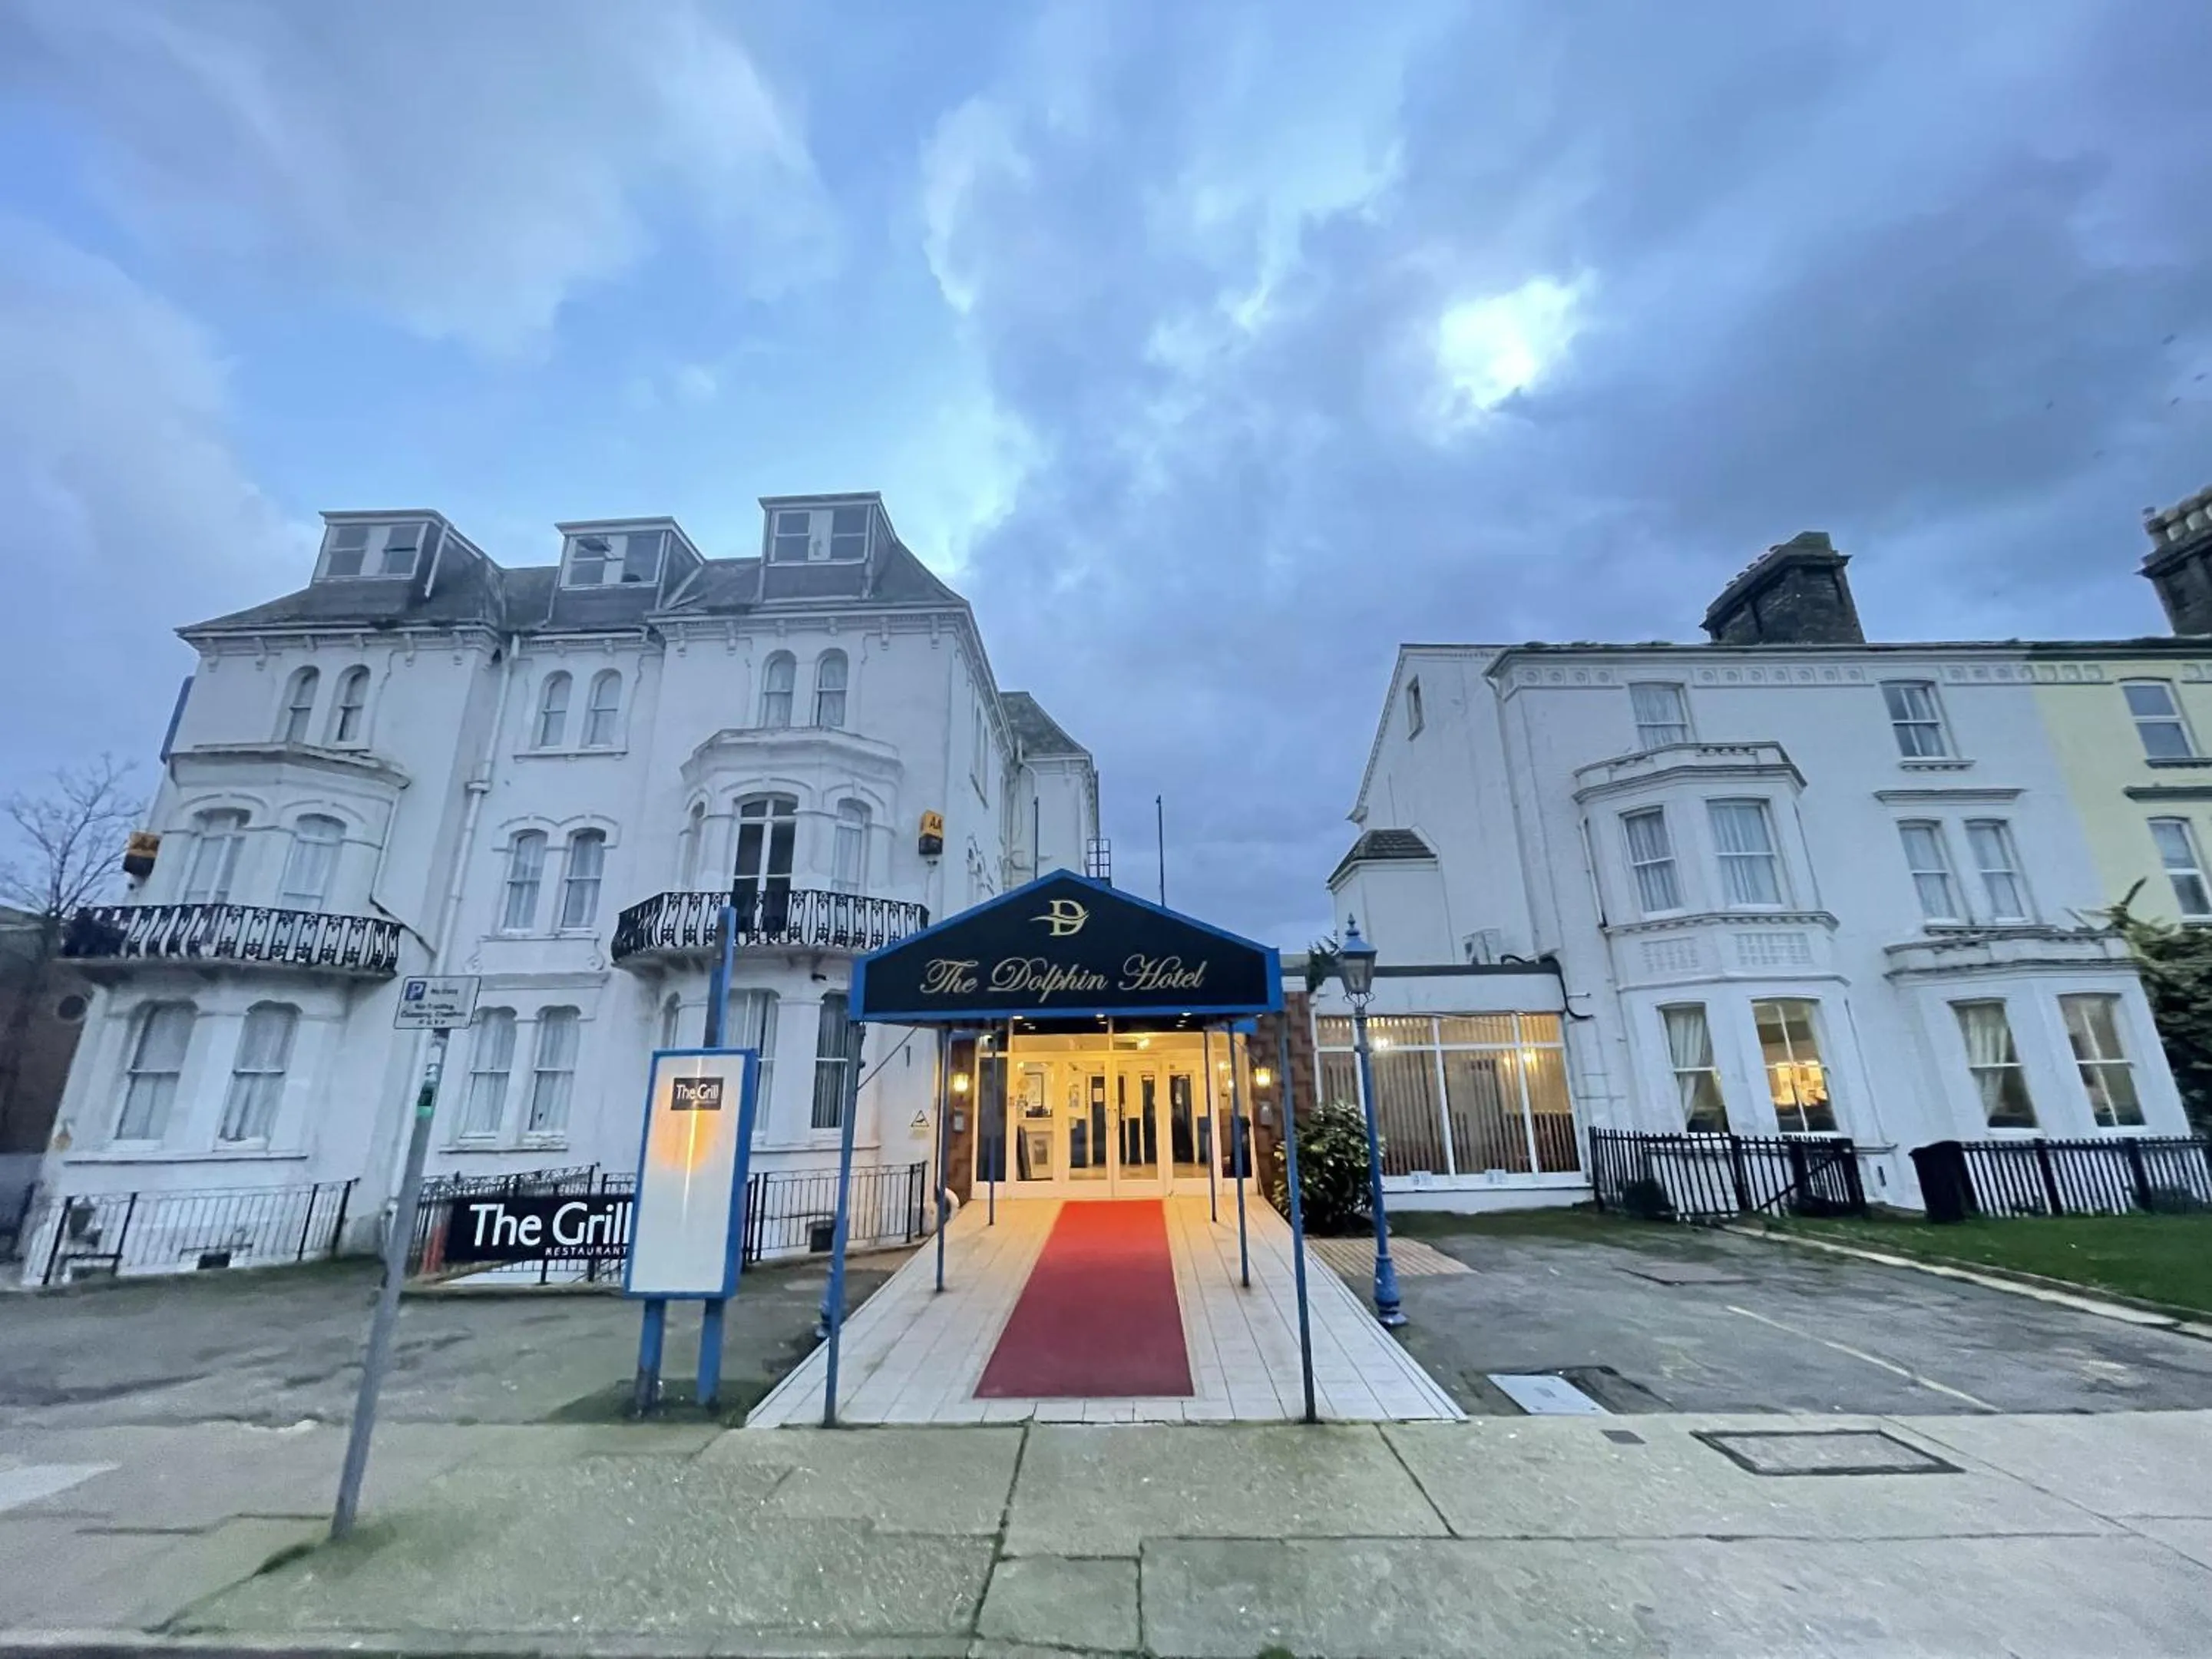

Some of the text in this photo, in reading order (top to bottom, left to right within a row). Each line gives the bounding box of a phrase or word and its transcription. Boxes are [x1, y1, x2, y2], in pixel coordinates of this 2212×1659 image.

[920, 953, 1208, 1003] The Dolphin Hotel
[676, 1083, 719, 1099] The Grill
[469, 1201, 633, 1247] The Grill
[545, 1246, 628, 1256] RESTAURANT
